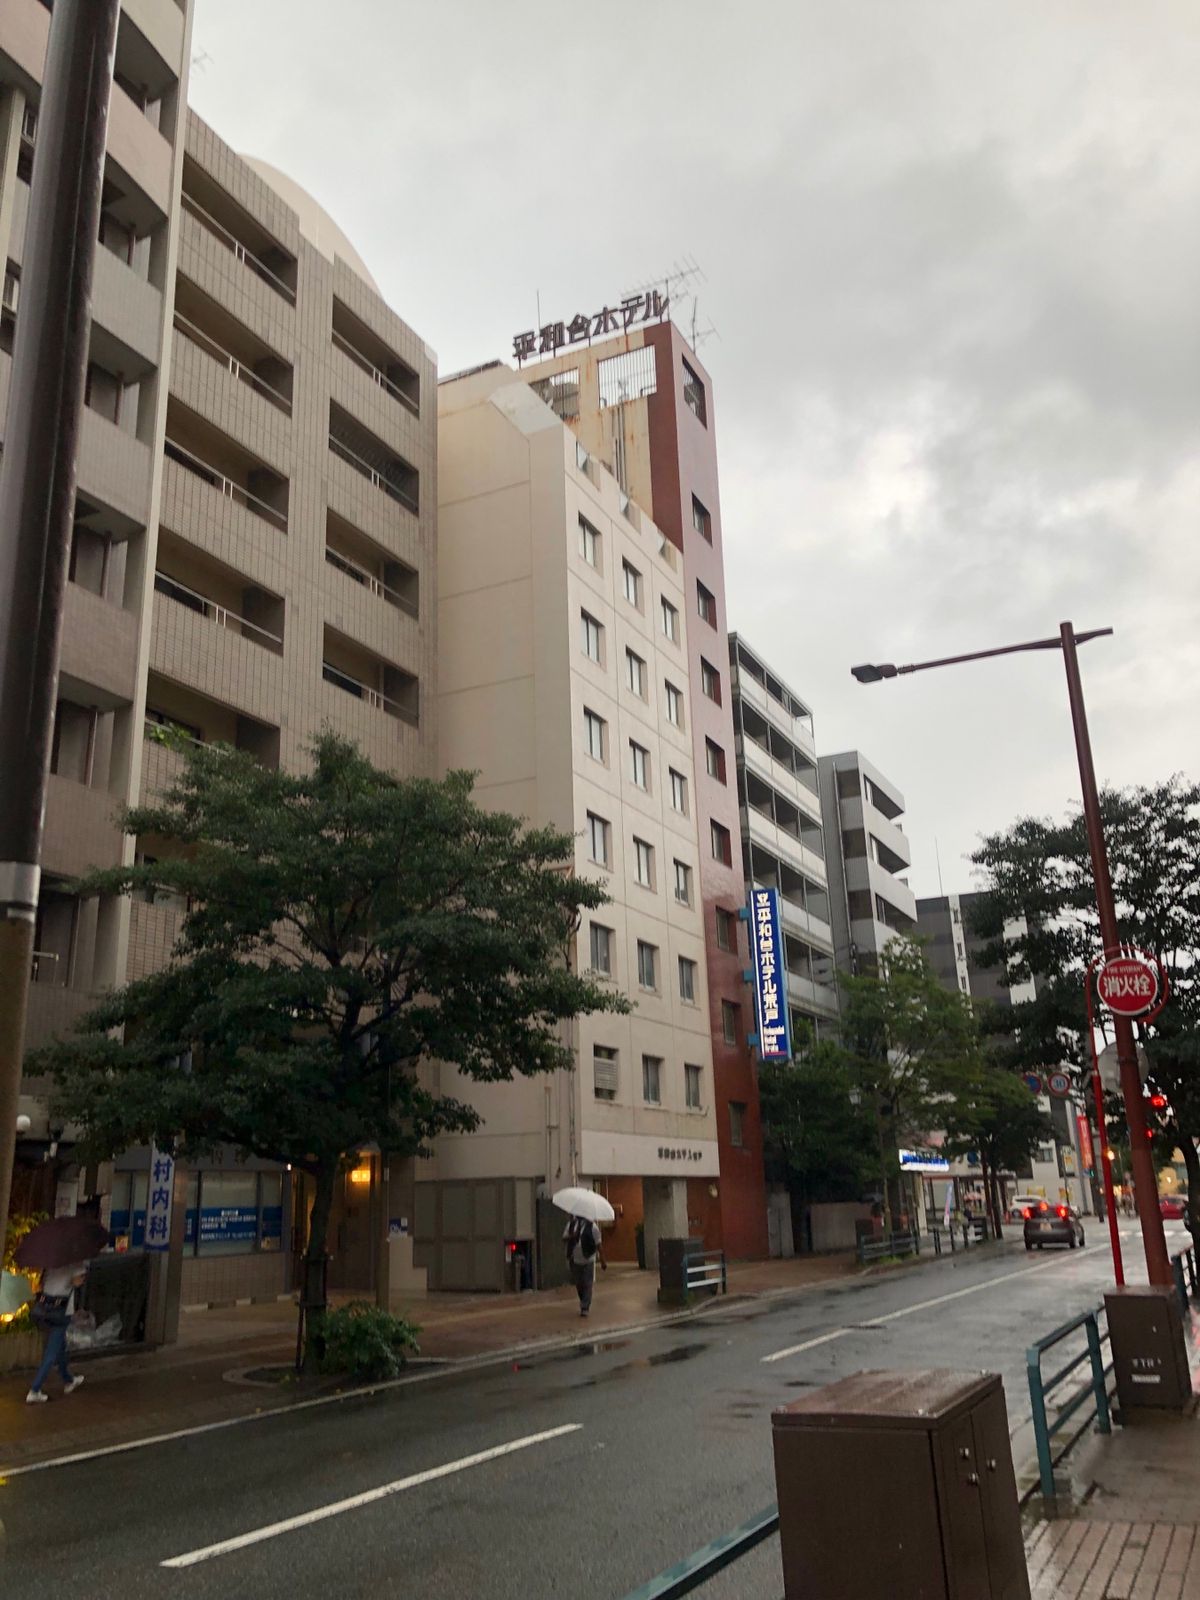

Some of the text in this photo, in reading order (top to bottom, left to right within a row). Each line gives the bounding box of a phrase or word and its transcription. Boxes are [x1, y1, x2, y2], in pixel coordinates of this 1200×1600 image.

[513, 290, 669, 360] 平和台ホテル
[757, 908, 779, 1025] 平和台ホテル荒戸
[1103, 974, 1151, 997] 消火栓
[150, 1159, 172, 1238] 村内科
